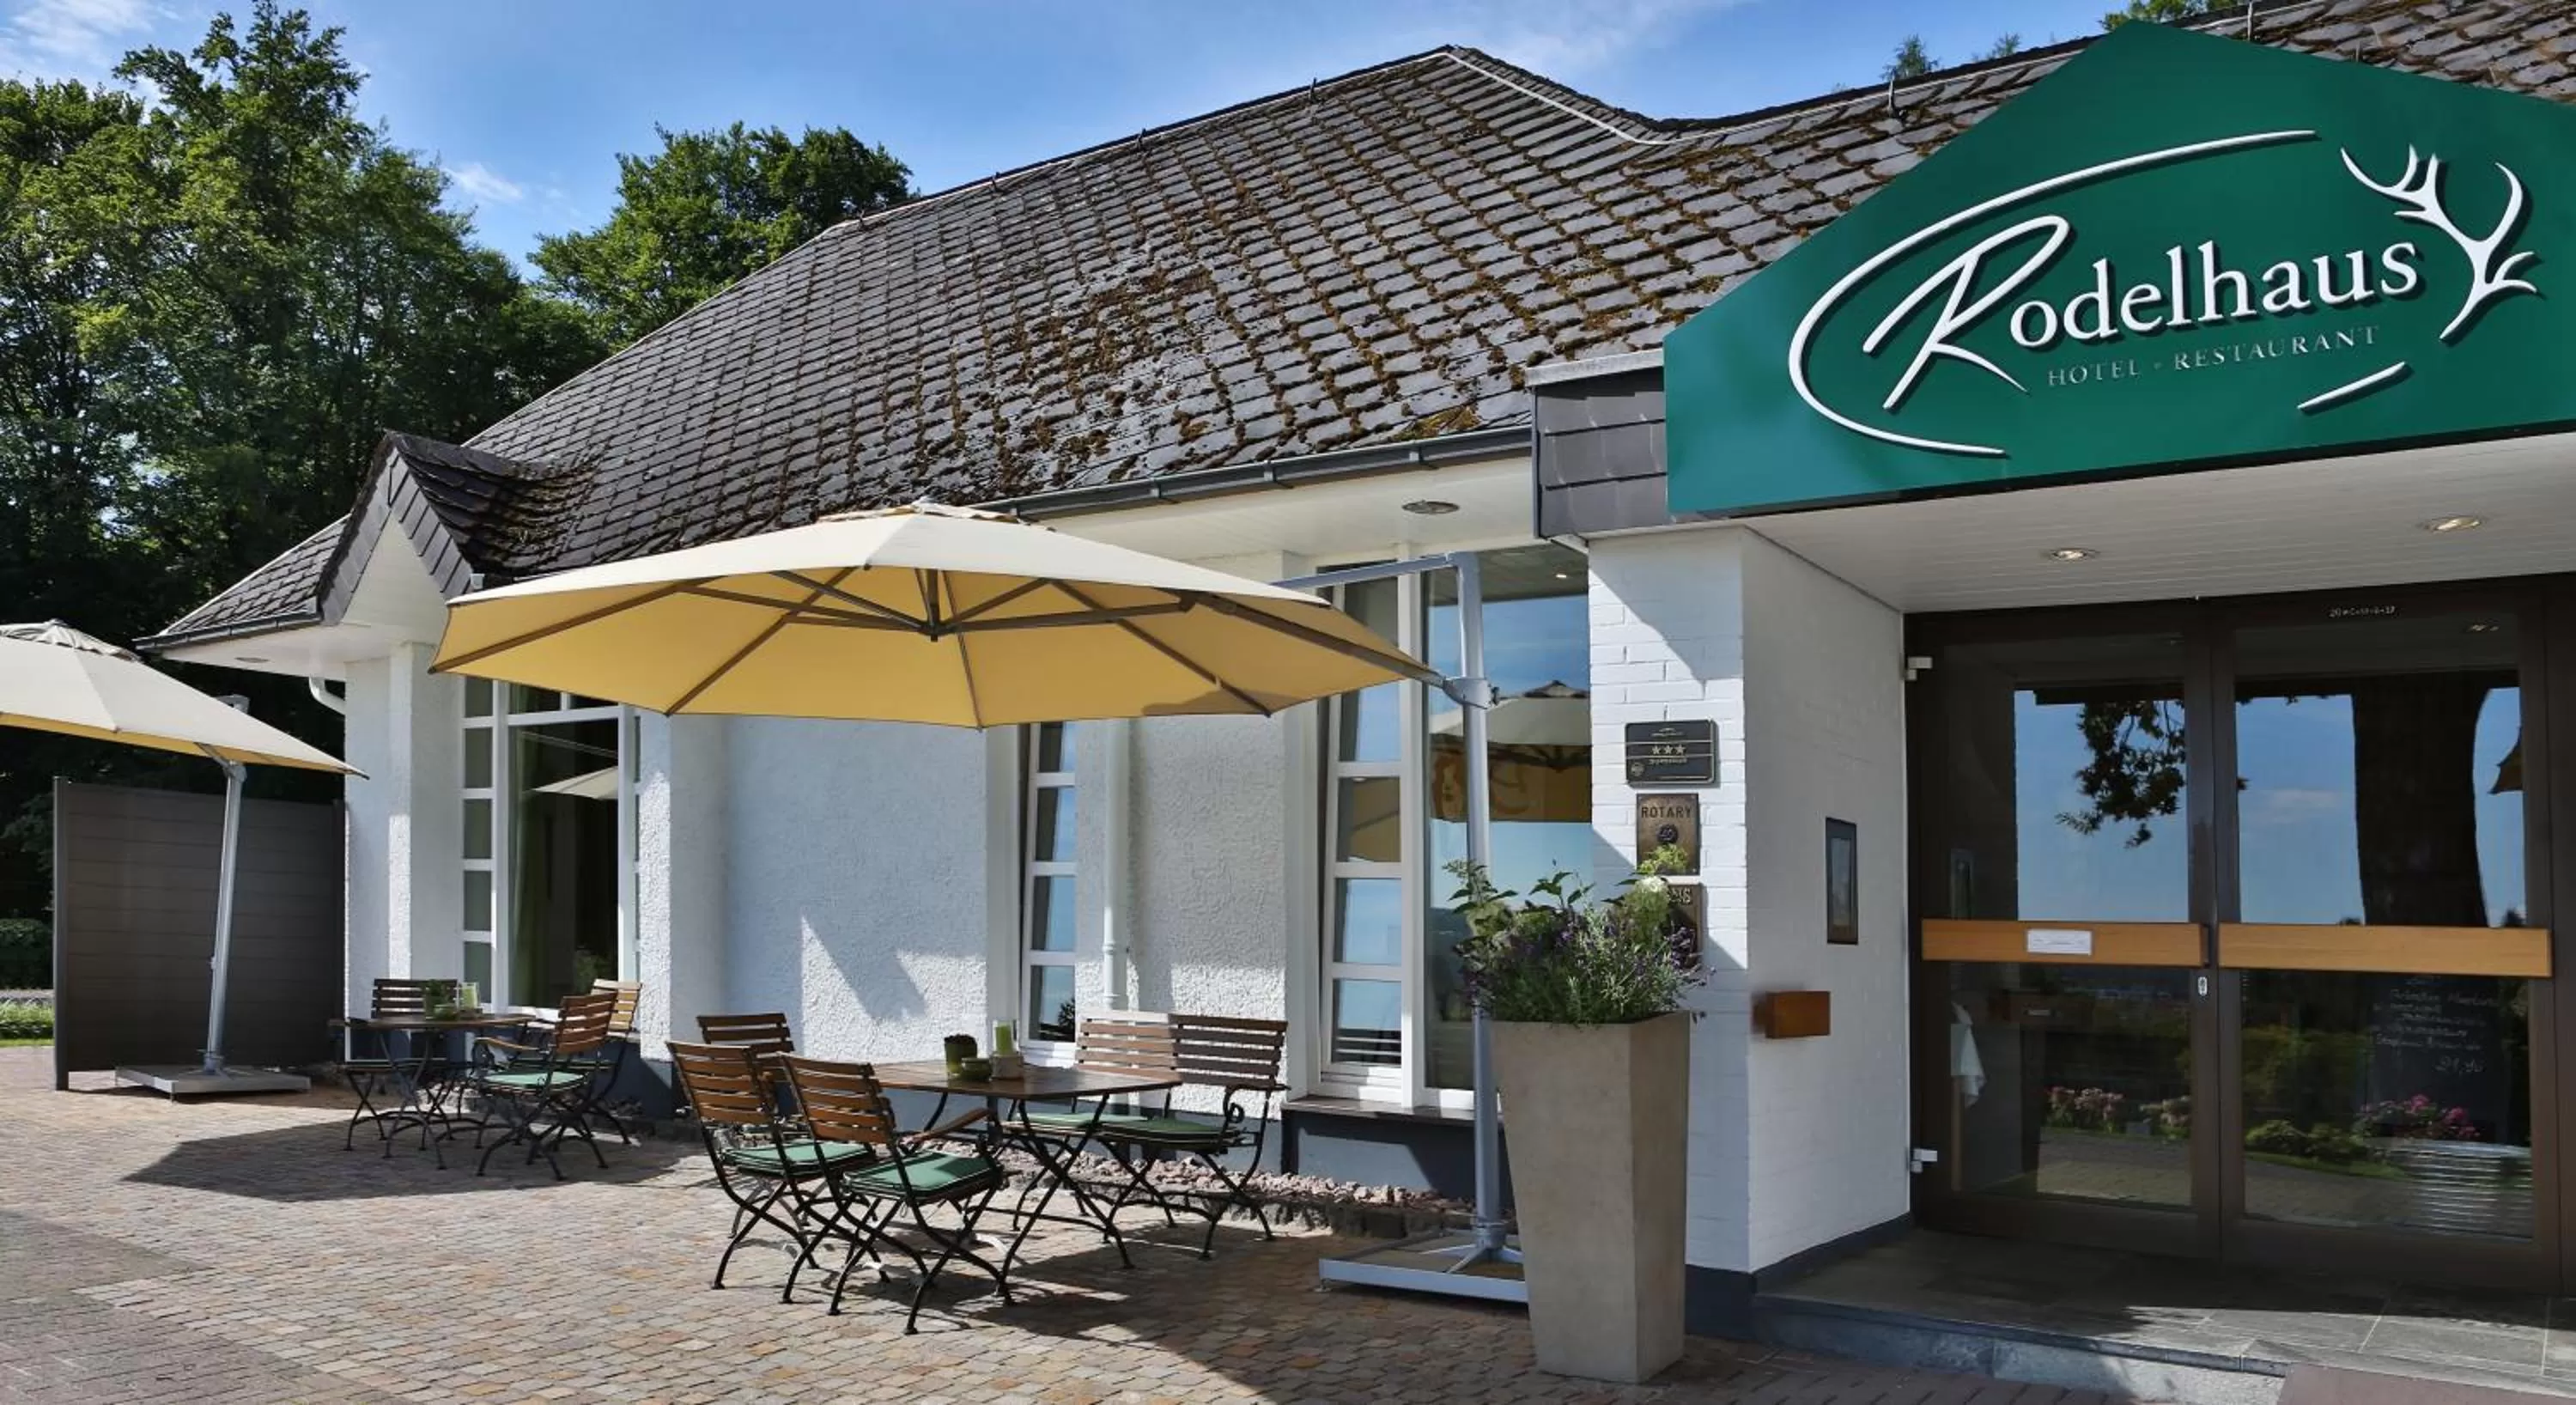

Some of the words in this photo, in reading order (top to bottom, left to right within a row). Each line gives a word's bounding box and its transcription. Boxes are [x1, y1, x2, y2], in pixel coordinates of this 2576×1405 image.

[1862, 216, 2418, 409] Rodelhaus
[2048, 358, 2141, 386] HOTEL
[2173, 325, 2380, 370] RESTAURANT
[1641, 806, 1691, 818] ROTARY
